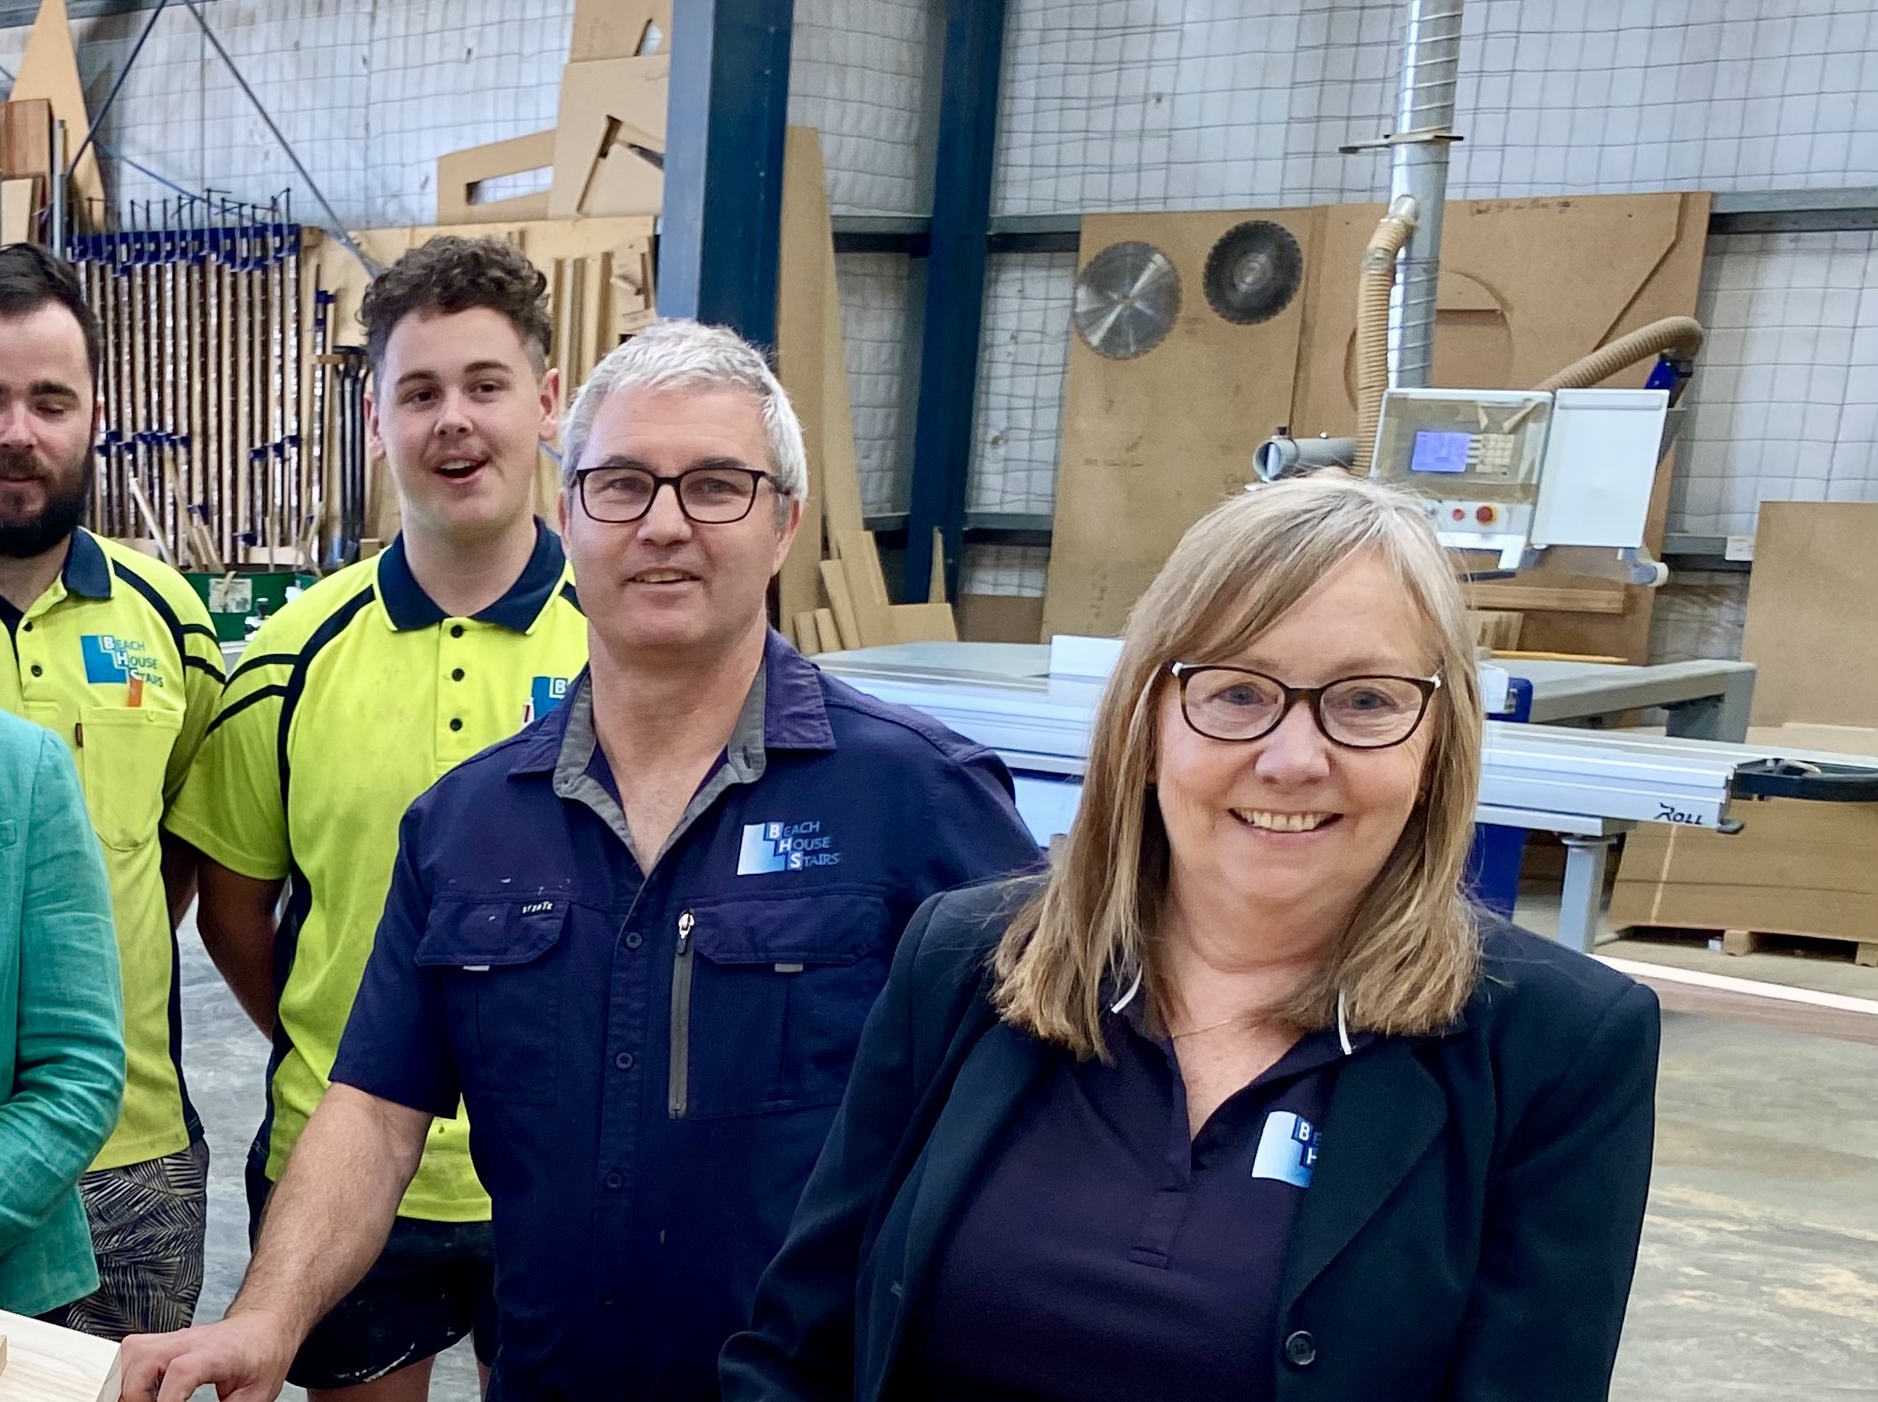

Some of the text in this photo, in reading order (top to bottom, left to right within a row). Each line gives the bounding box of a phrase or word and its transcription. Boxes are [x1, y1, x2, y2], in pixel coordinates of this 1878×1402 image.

[103, 635, 145, 651] BEACH
[116, 651, 158, 669] HOUSE
[769, 821, 820, 839] BEACH
[779, 837, 831, 853] HOUSE
[789, 852, 841, 869] STAIRS
